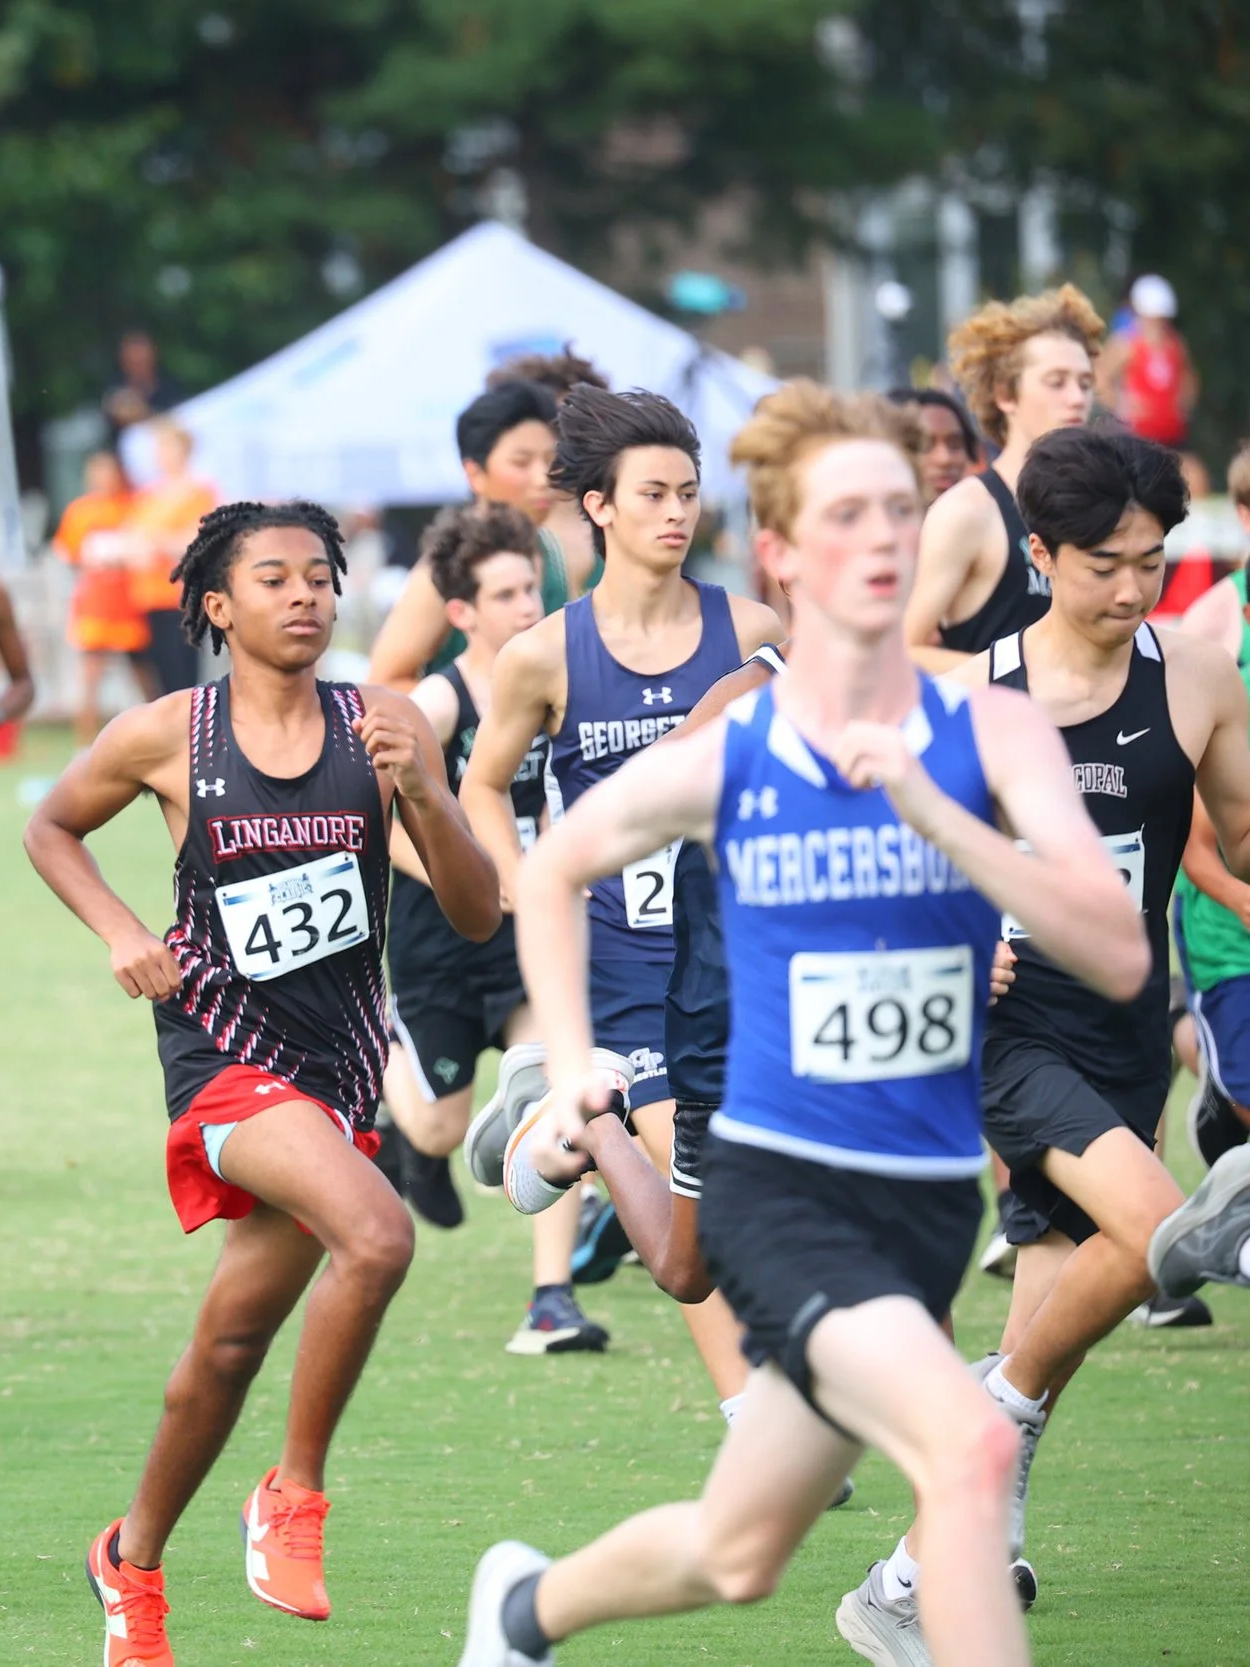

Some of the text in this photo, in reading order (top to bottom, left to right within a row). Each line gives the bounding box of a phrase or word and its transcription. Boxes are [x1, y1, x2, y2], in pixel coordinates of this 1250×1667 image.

[210, 814, 366, 857] LINGANORE
[724, 823, 969, 906] MERCERSBU
[244, 888, 358, 964] 432
[812, 992, 957, 1064] 498
